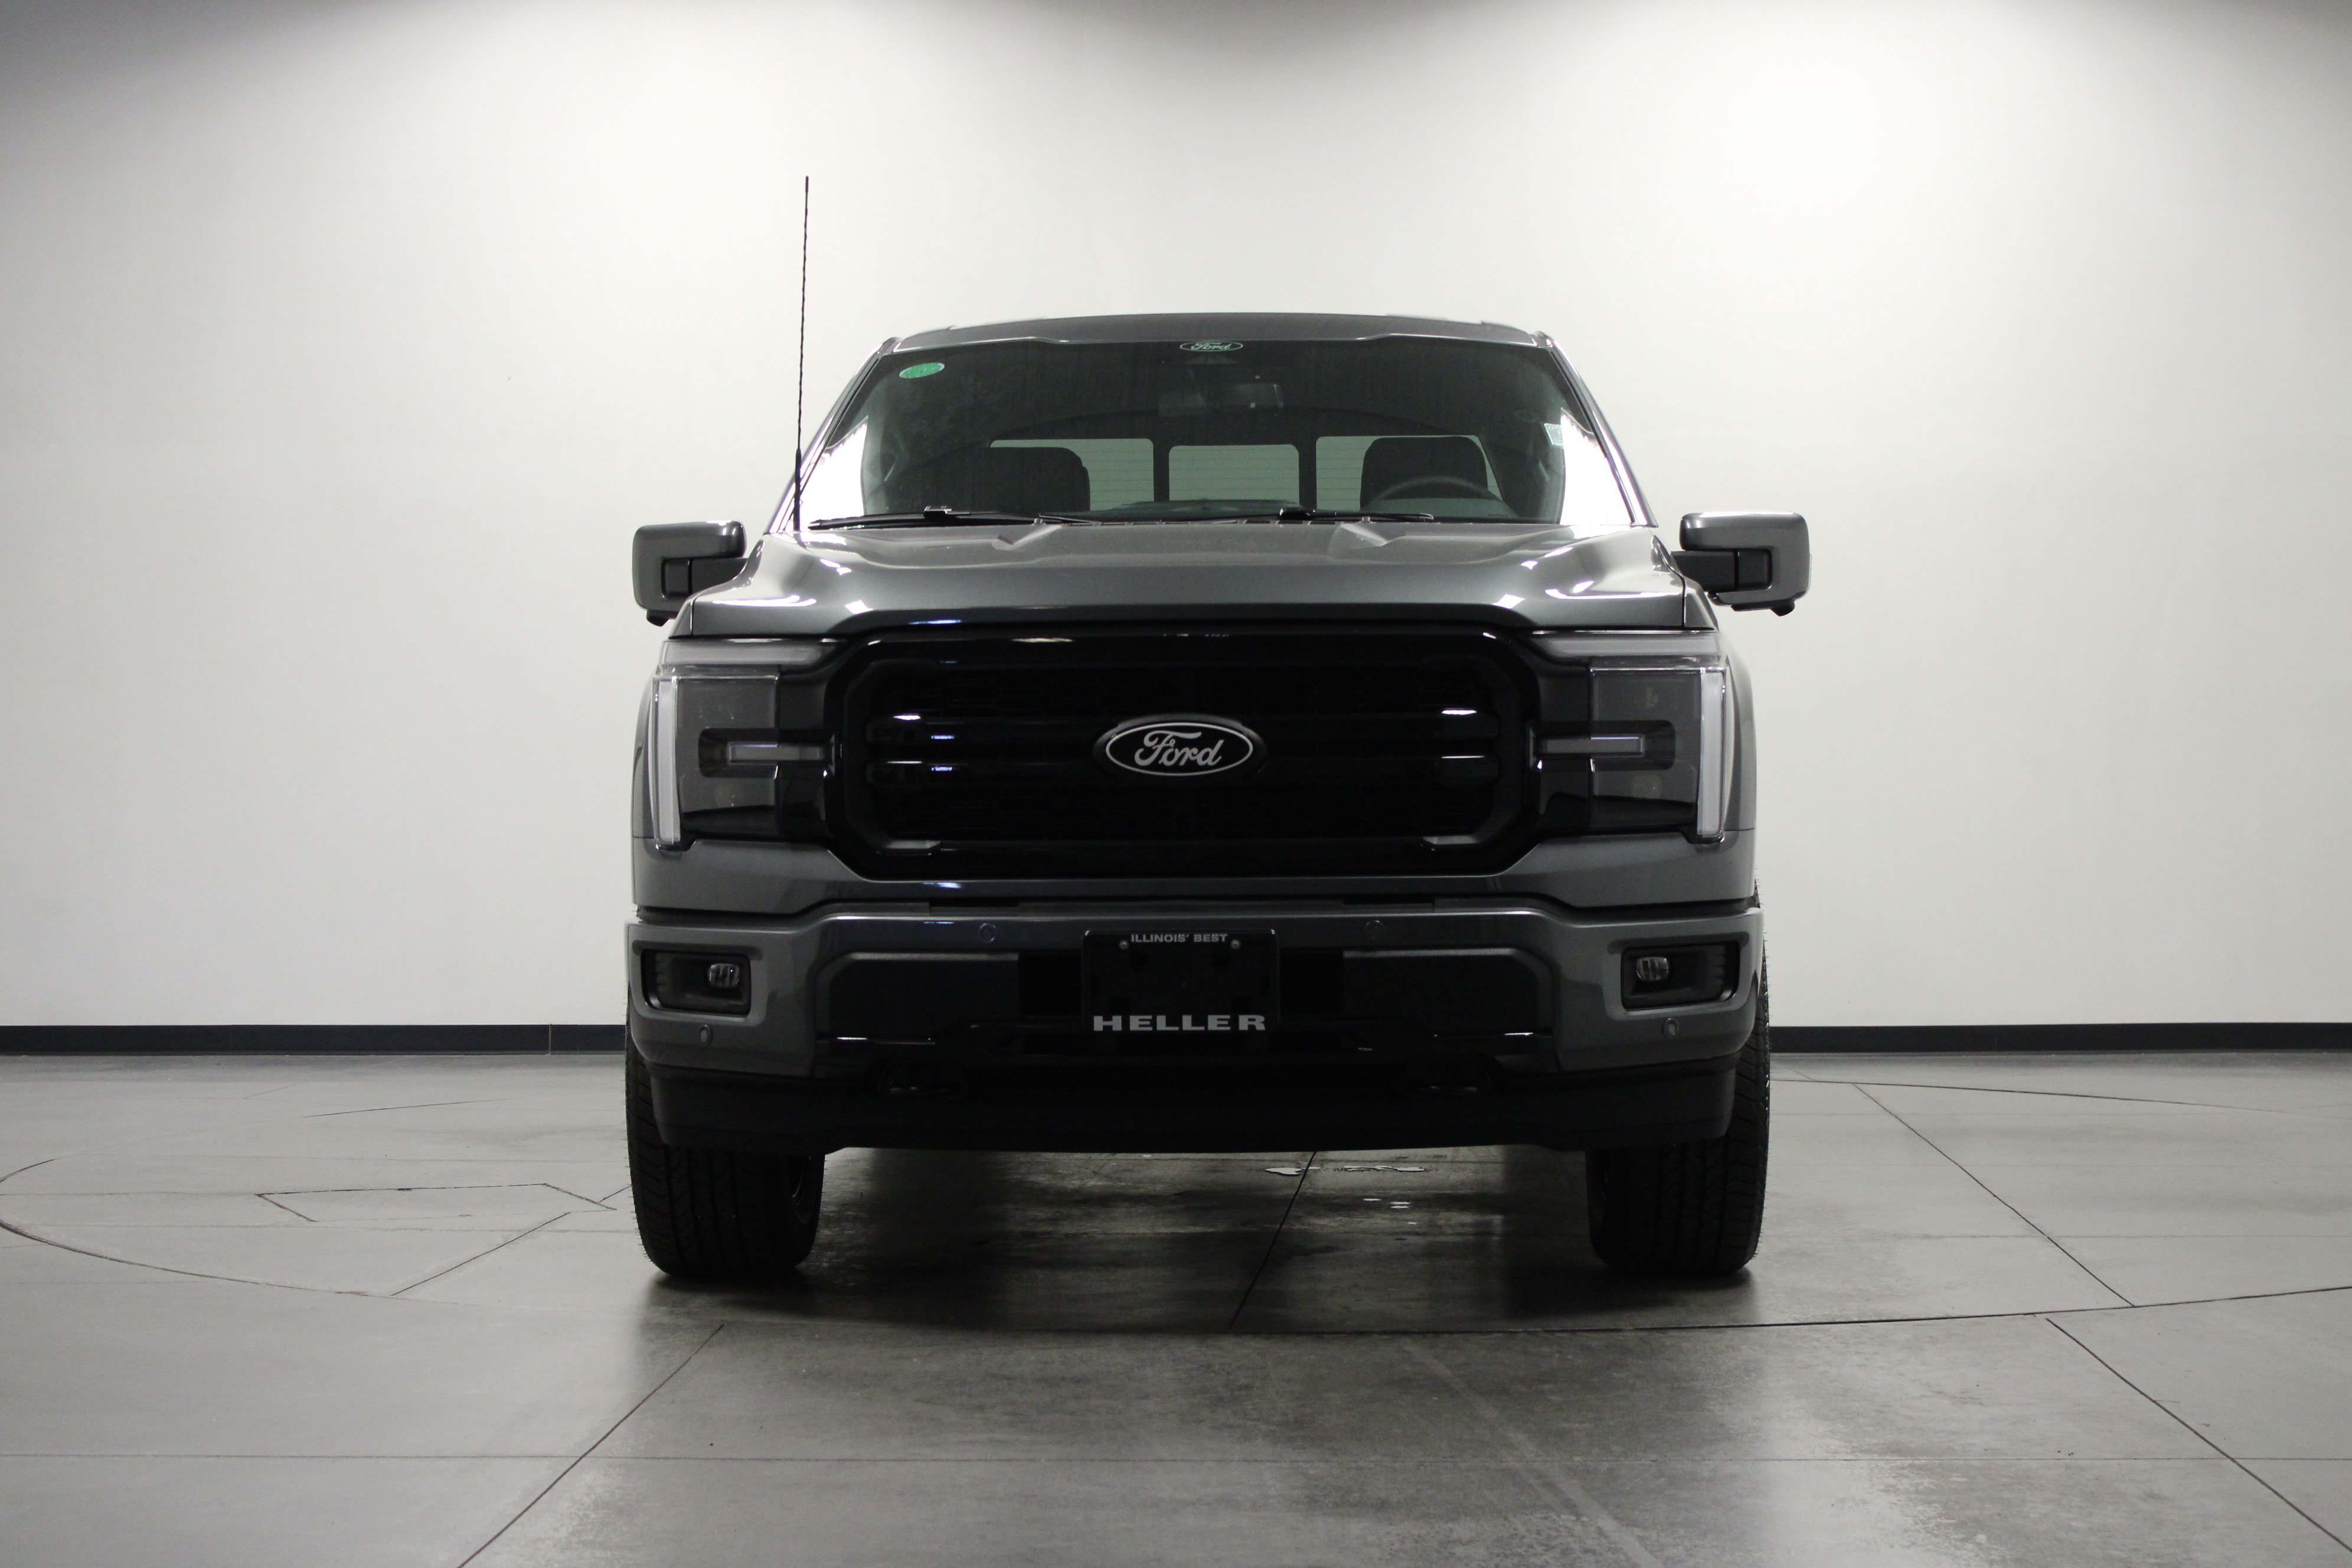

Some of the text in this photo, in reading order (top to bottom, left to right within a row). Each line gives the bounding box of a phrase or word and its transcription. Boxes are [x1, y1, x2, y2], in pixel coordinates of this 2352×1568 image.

[1134, 730, 1224, 766] Ford
[1131, 933, 1228, 943] ILLINOIS' BEST
[1093, 1014, 1266, 1031] HELLER
